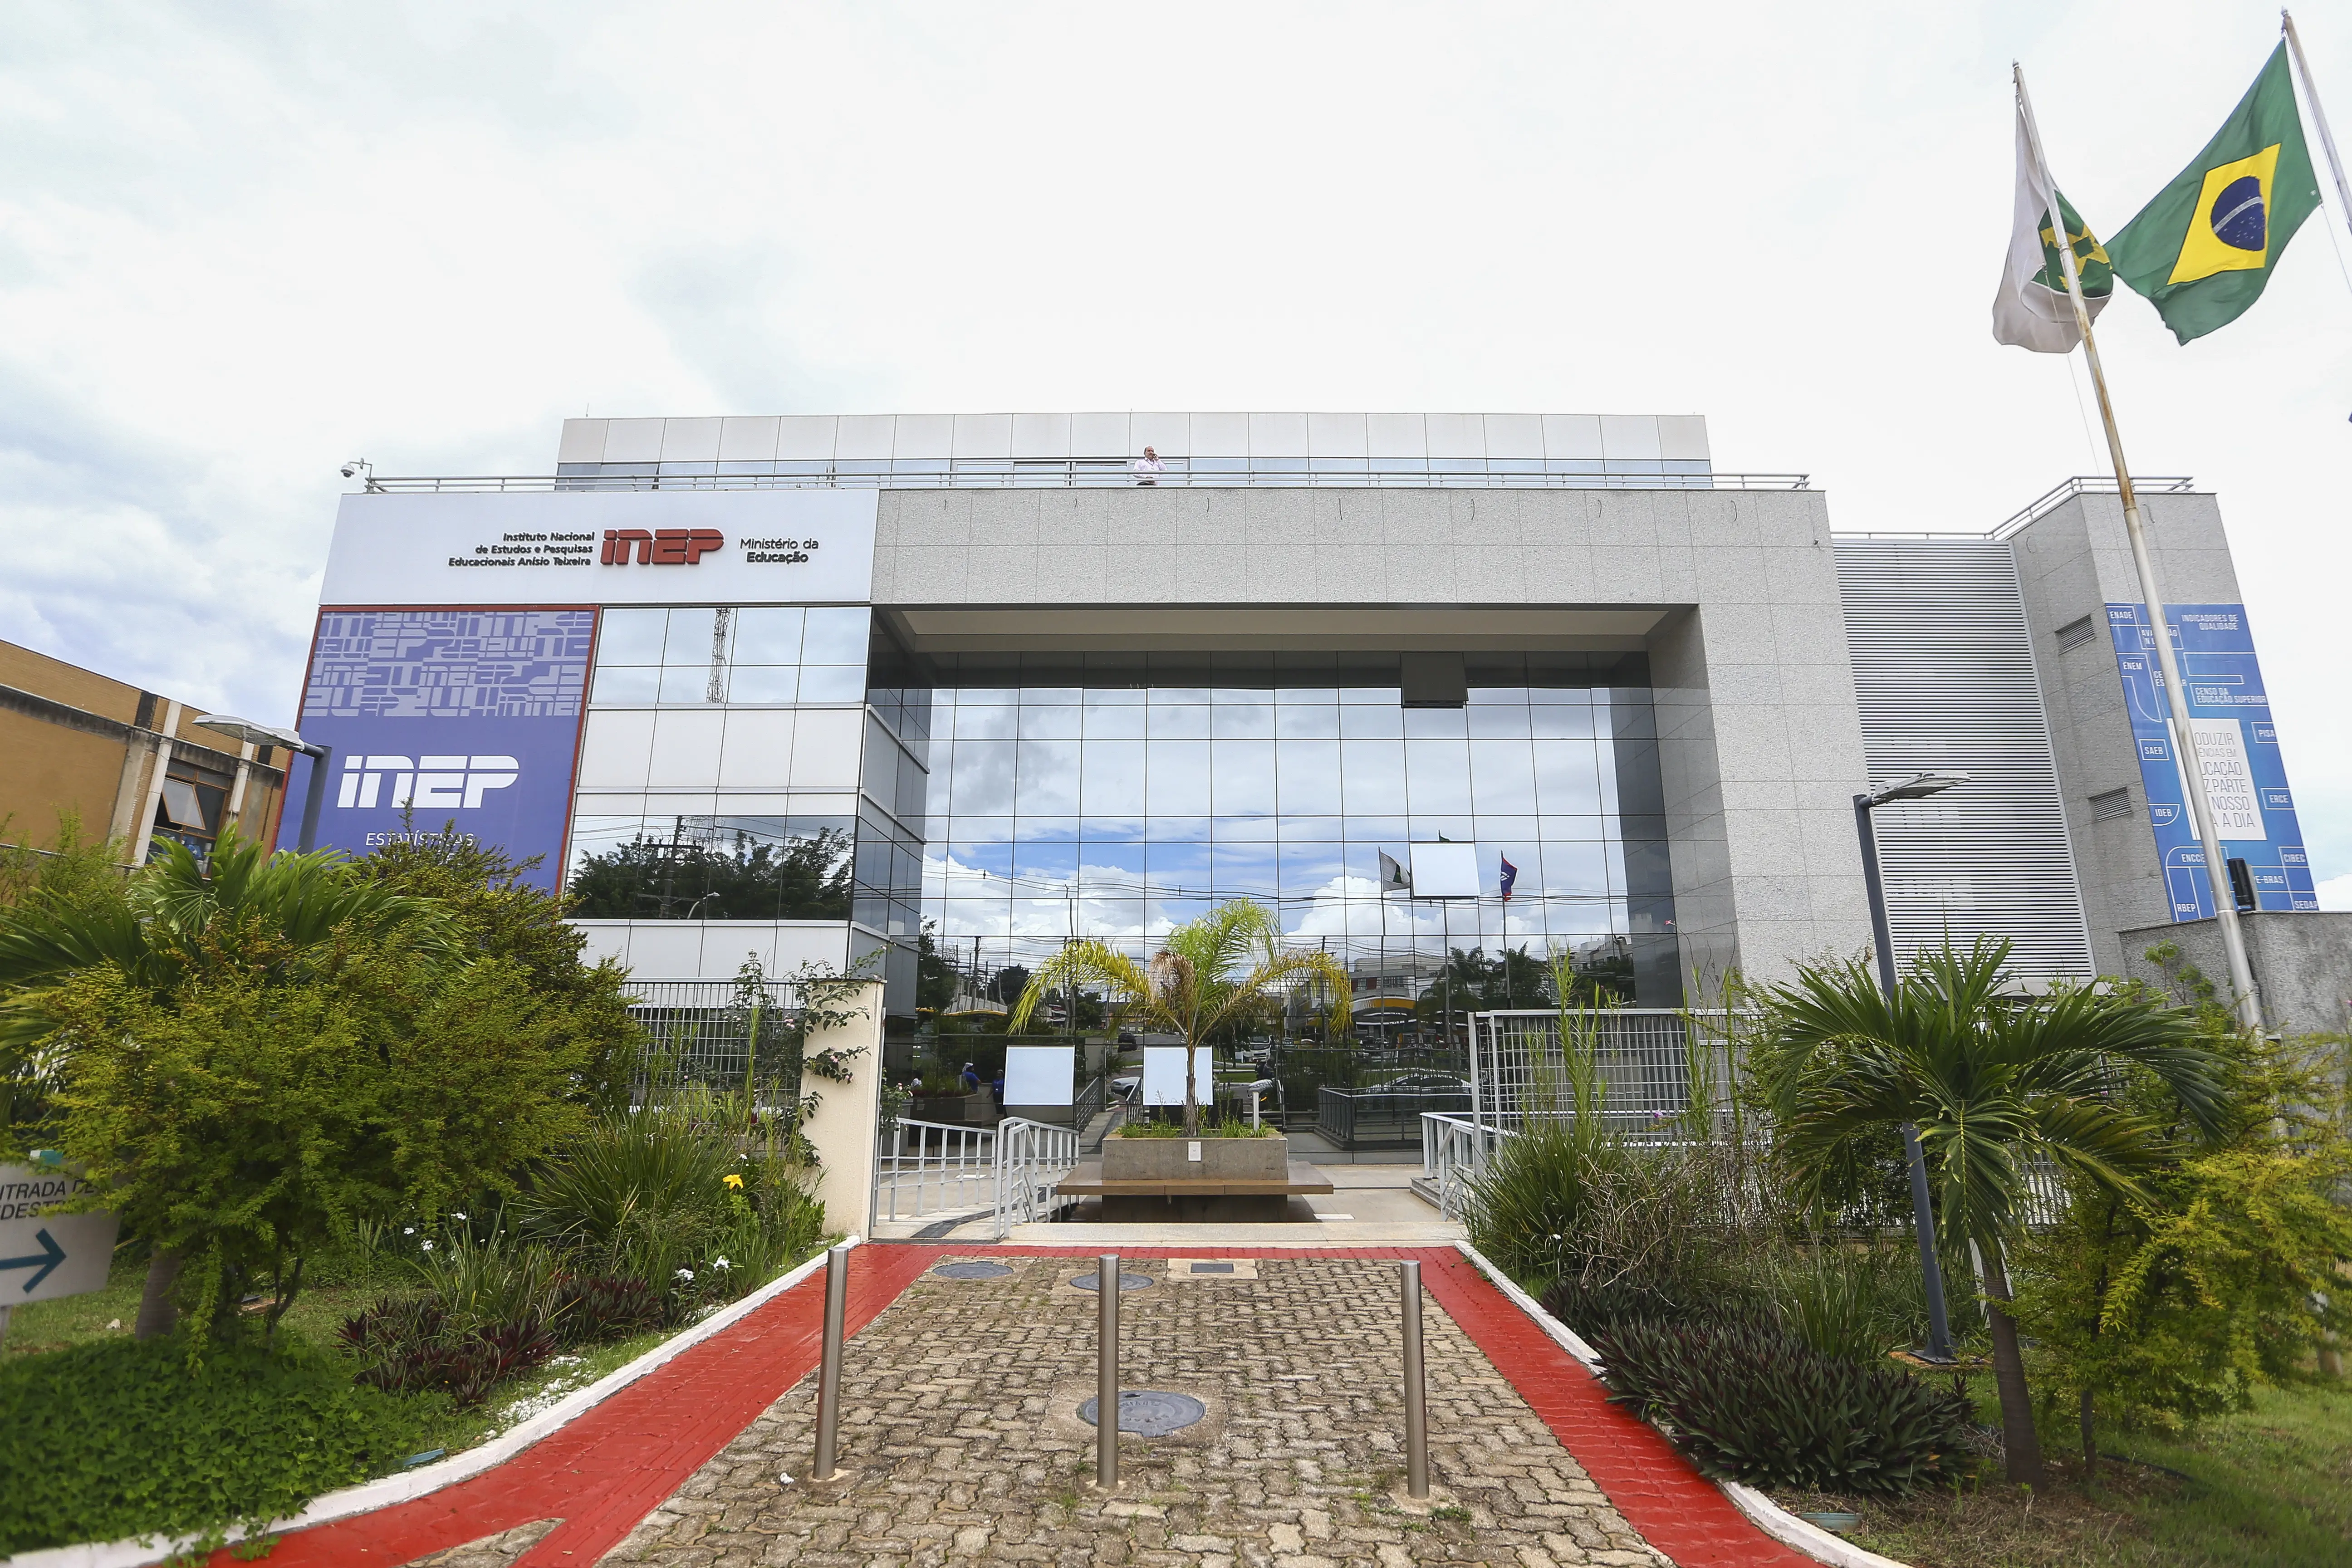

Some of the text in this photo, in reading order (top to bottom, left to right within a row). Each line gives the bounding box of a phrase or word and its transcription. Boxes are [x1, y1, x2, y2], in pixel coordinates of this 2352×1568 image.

[503, 532, 594, 541] Instituto Nacional
[740, 538, 819, 549] Ministério da
[475, 545, 488, 554] de
[491, 545, 532, 554] Estudos
[544, 545, 593, 555] Pesquisas
[449, 557, 591, 567] Educacionais Anísio Teixeira
[747, 552, 808, 564] Educação
[2197, 694, 2233, 704] EDUCAÇÃO
[2145, 746, 2163, 755] SAEB
[2212, 779, 2248, 793] PARTE
[2211, 796, 2250, 810] NOSSO
[2155, 808, 2172, 817] IDEB
[2223, 813, 2231, 827] A
[2233, 813, 2256, 827] DIA
[2176, 904, 2195, 912] RBEP
